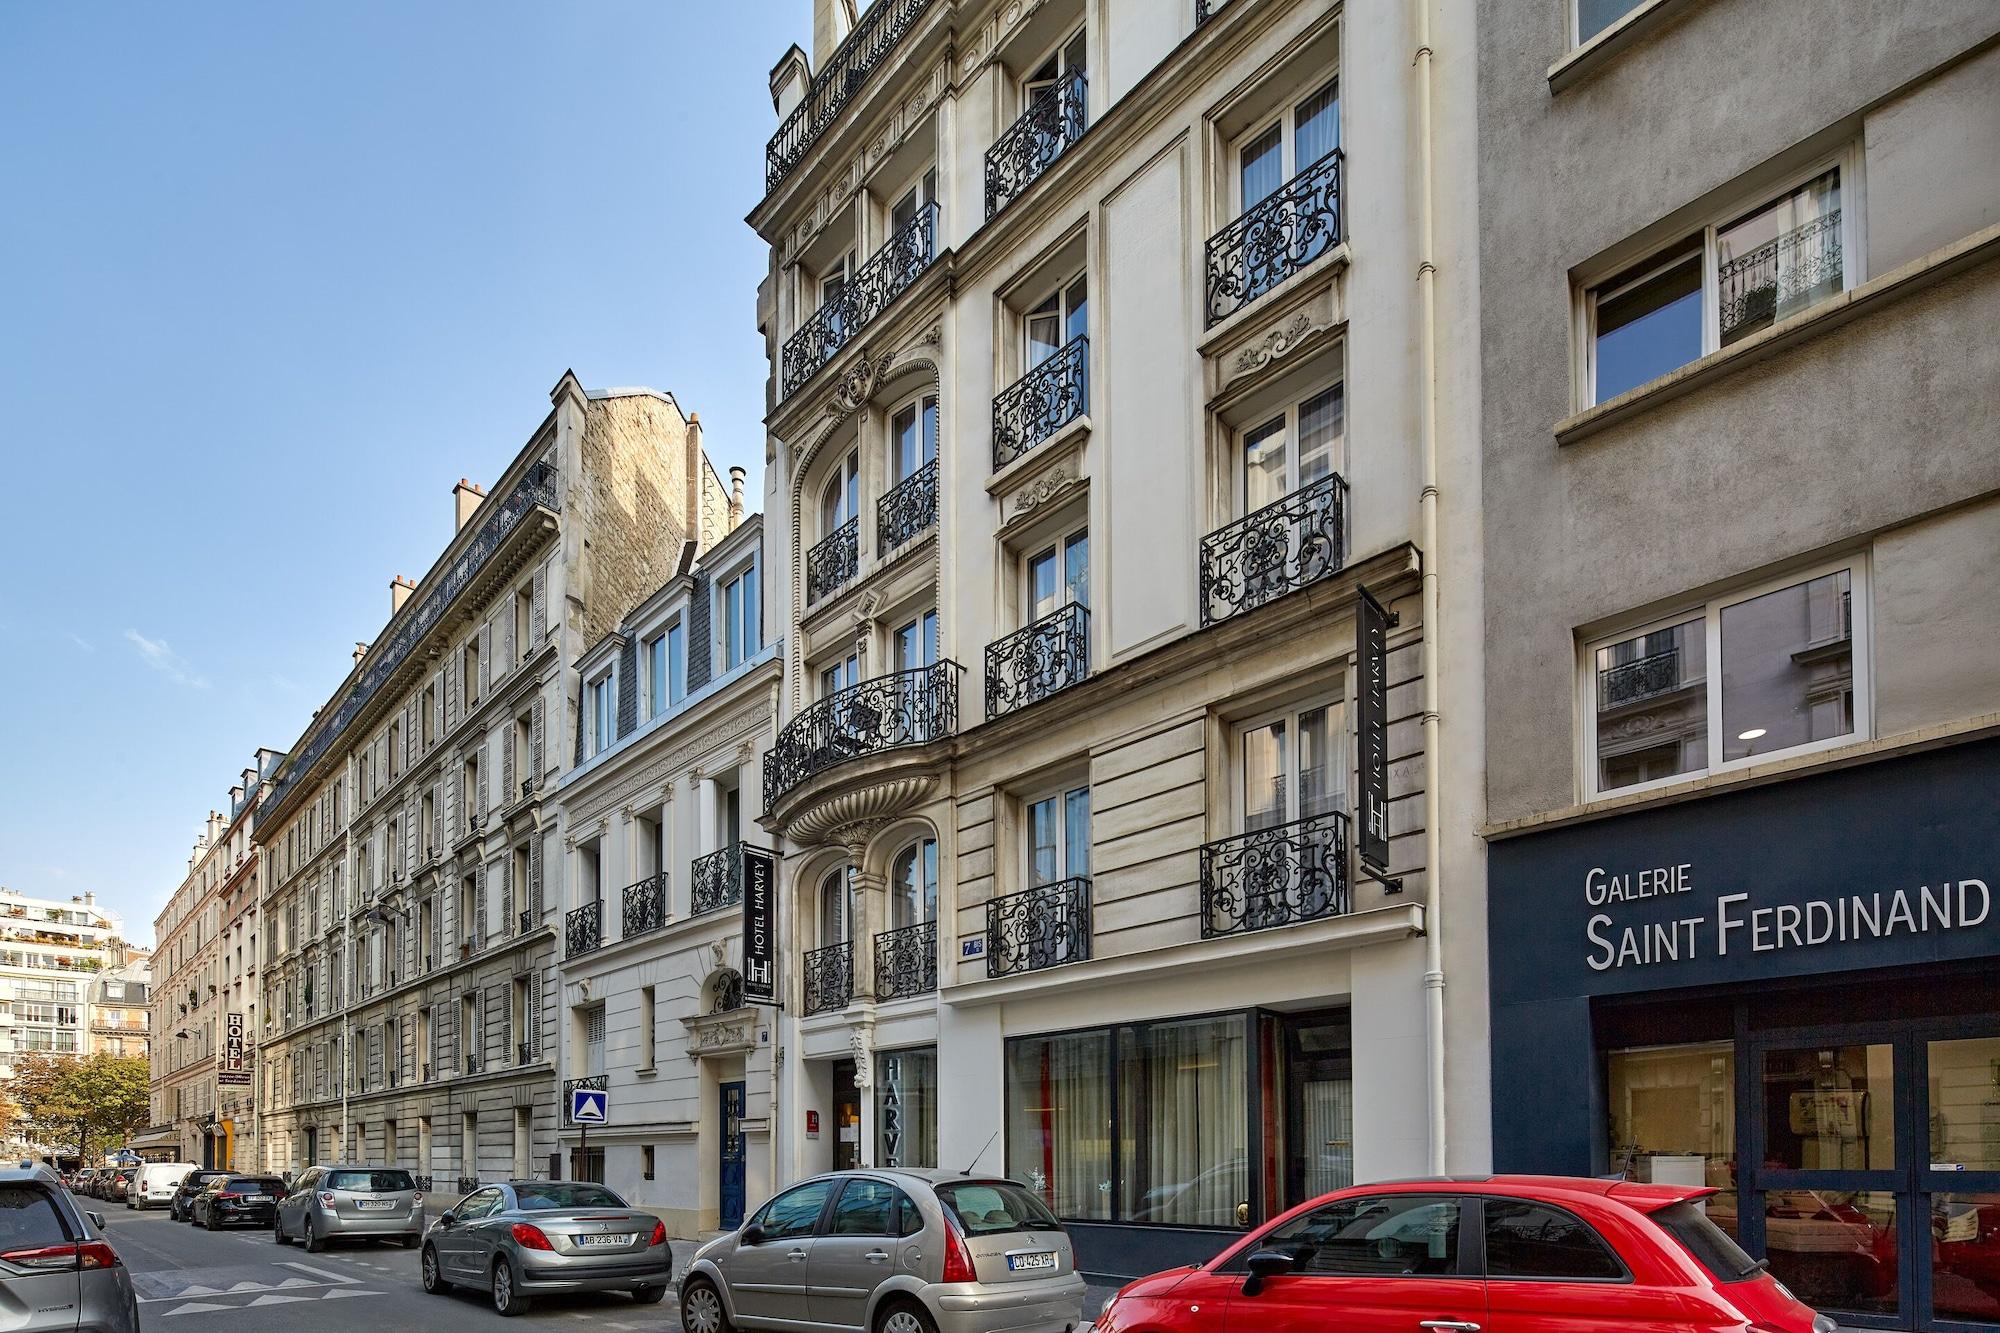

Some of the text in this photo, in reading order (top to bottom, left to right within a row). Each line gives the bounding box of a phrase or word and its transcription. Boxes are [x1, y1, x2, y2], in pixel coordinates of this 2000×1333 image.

[754, 860, 765, 955] HOTEL HARVEY
[1585, 863, 1692, 906] GALERIE
[964, 942, 971, 955] 7
[1586, 878, 1991, 971] SAINT FERDINAND
[228, 1014, 242, 1070] HOTEL
